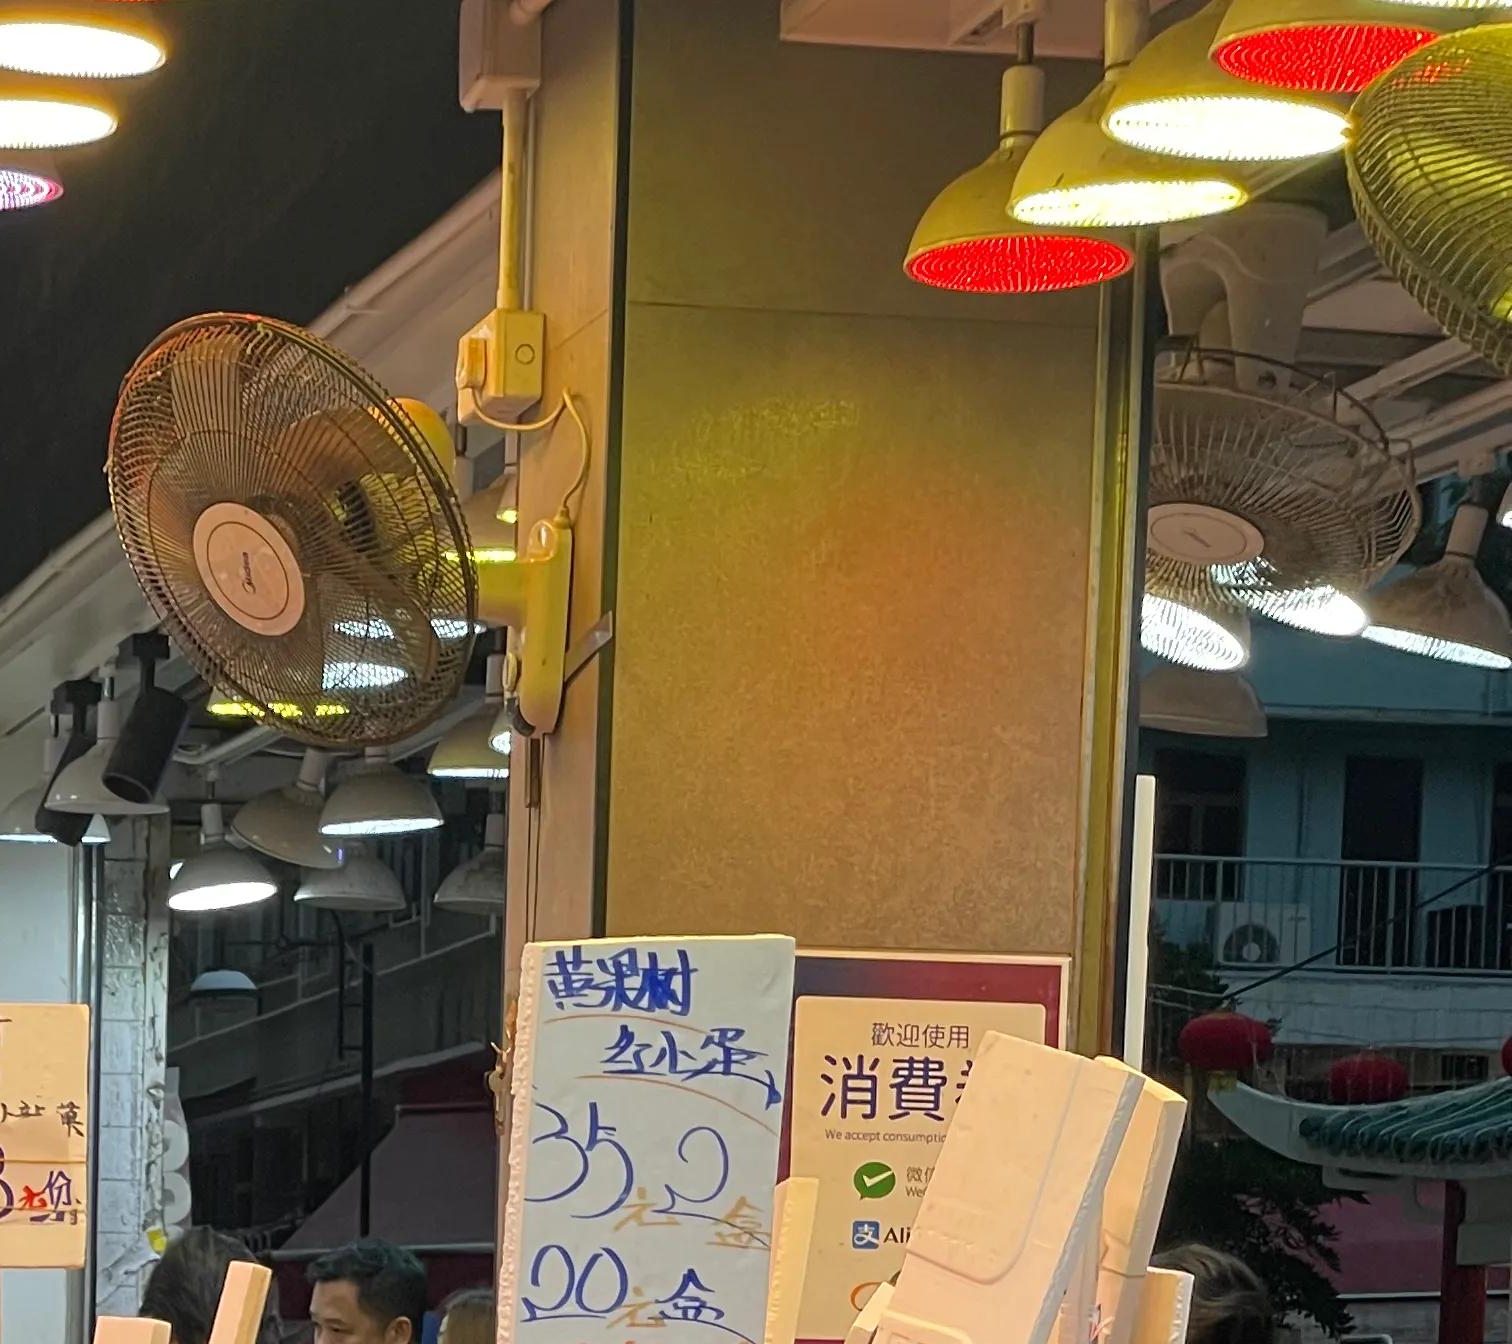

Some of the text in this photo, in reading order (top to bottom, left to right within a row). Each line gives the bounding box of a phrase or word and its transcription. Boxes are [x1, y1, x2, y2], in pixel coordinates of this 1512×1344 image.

[871, 1023, 970, 1050] 歡迎使用
[825, 1128, 947, 1145] We accept consumptio
